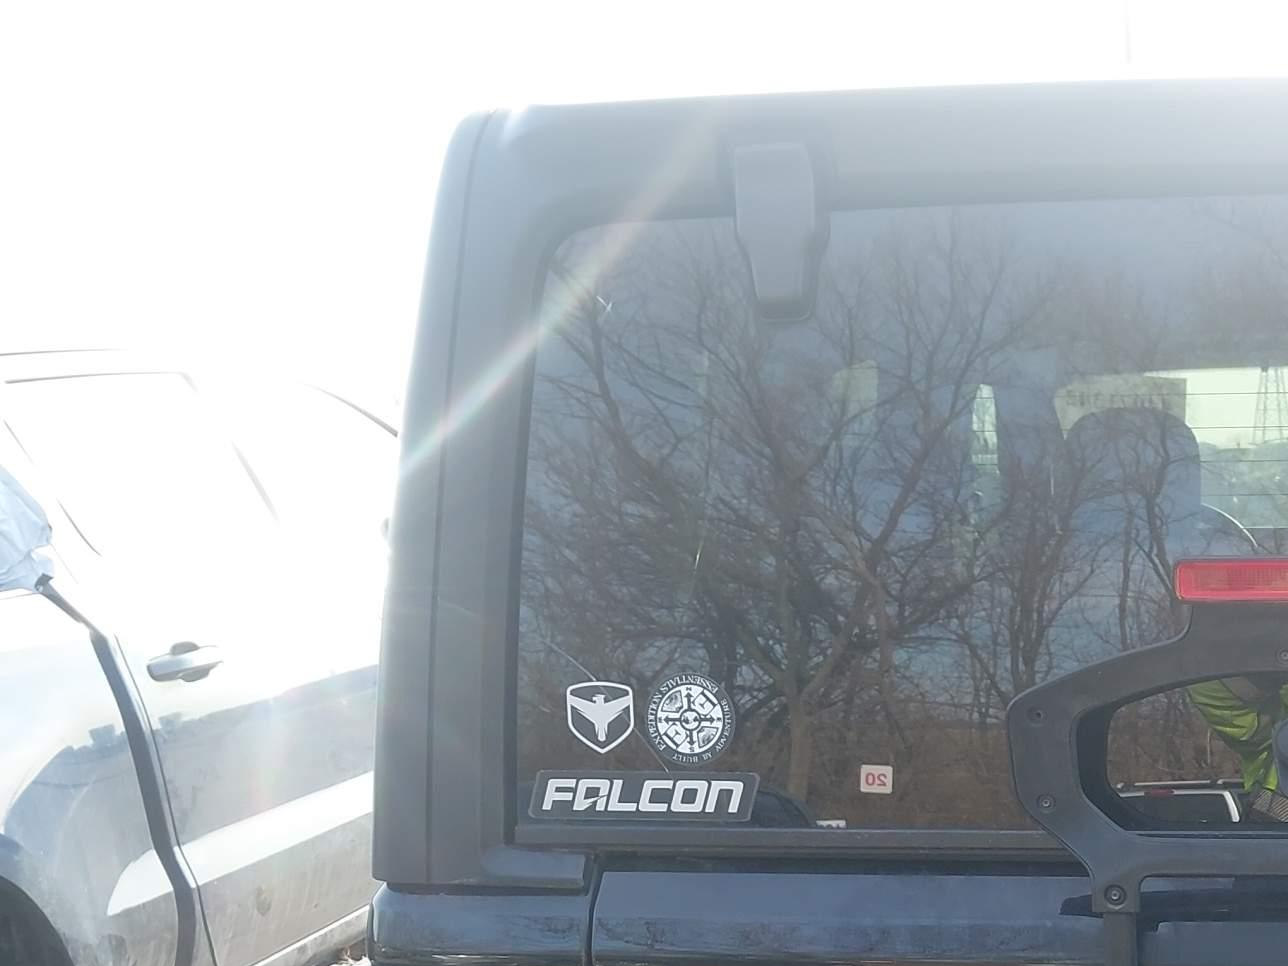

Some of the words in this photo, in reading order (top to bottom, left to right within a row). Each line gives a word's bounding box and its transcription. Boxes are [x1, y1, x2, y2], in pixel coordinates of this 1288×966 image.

[648, 691, 667, 751] EXPEDITION
[660, 675, 719, 694] ESSENTIALS
[672, 753, 699, 763] BUILT
[715, 698, 732, 752] ADVENTURE
[542, 778, 744, 813] FALCON
